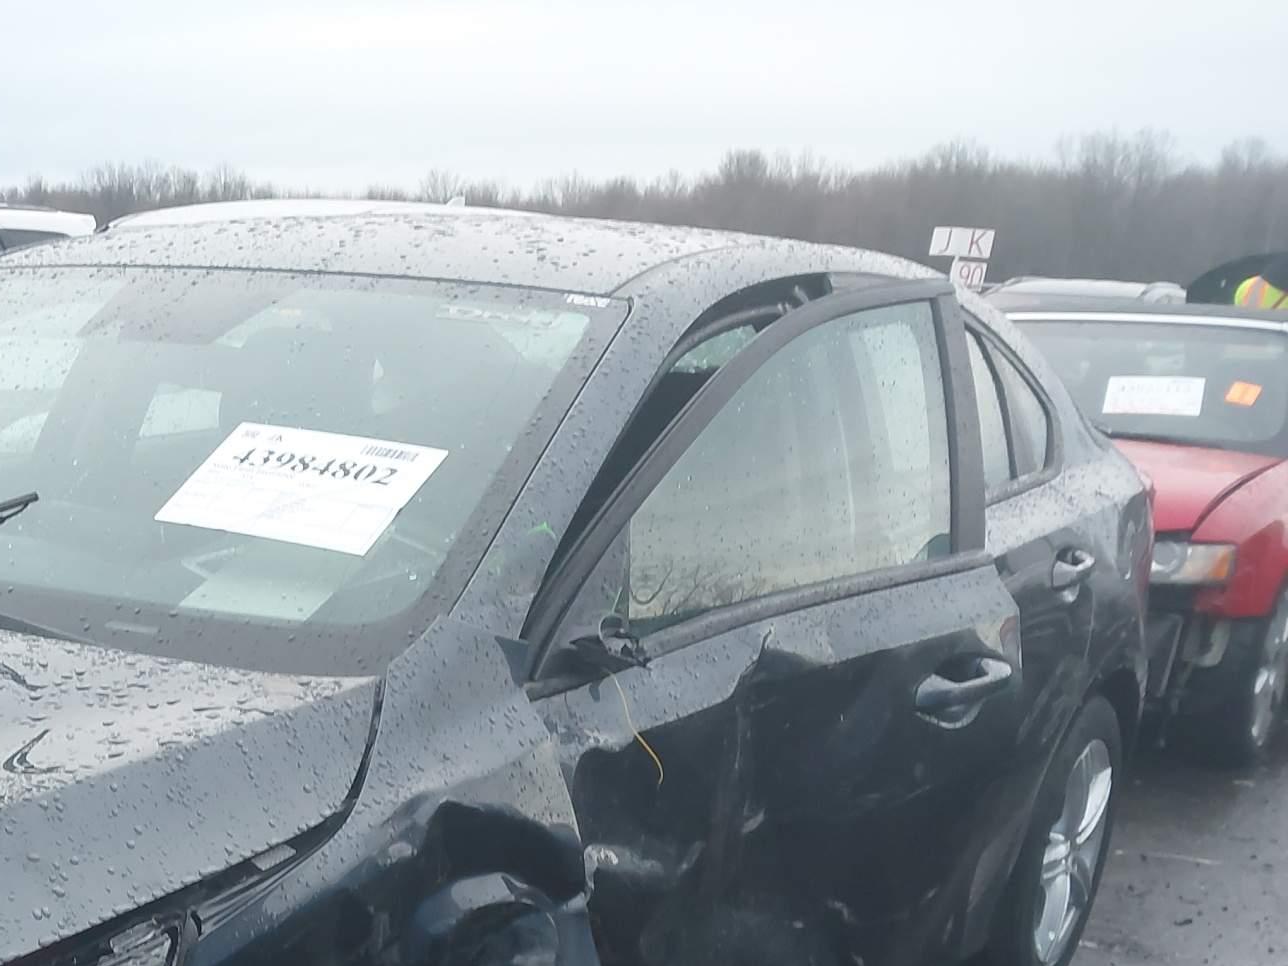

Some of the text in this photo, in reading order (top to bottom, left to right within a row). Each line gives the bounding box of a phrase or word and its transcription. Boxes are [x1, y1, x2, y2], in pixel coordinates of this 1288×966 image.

[936, 228, 988, 256] J K
[232, 447, 399, 487] 43984802
